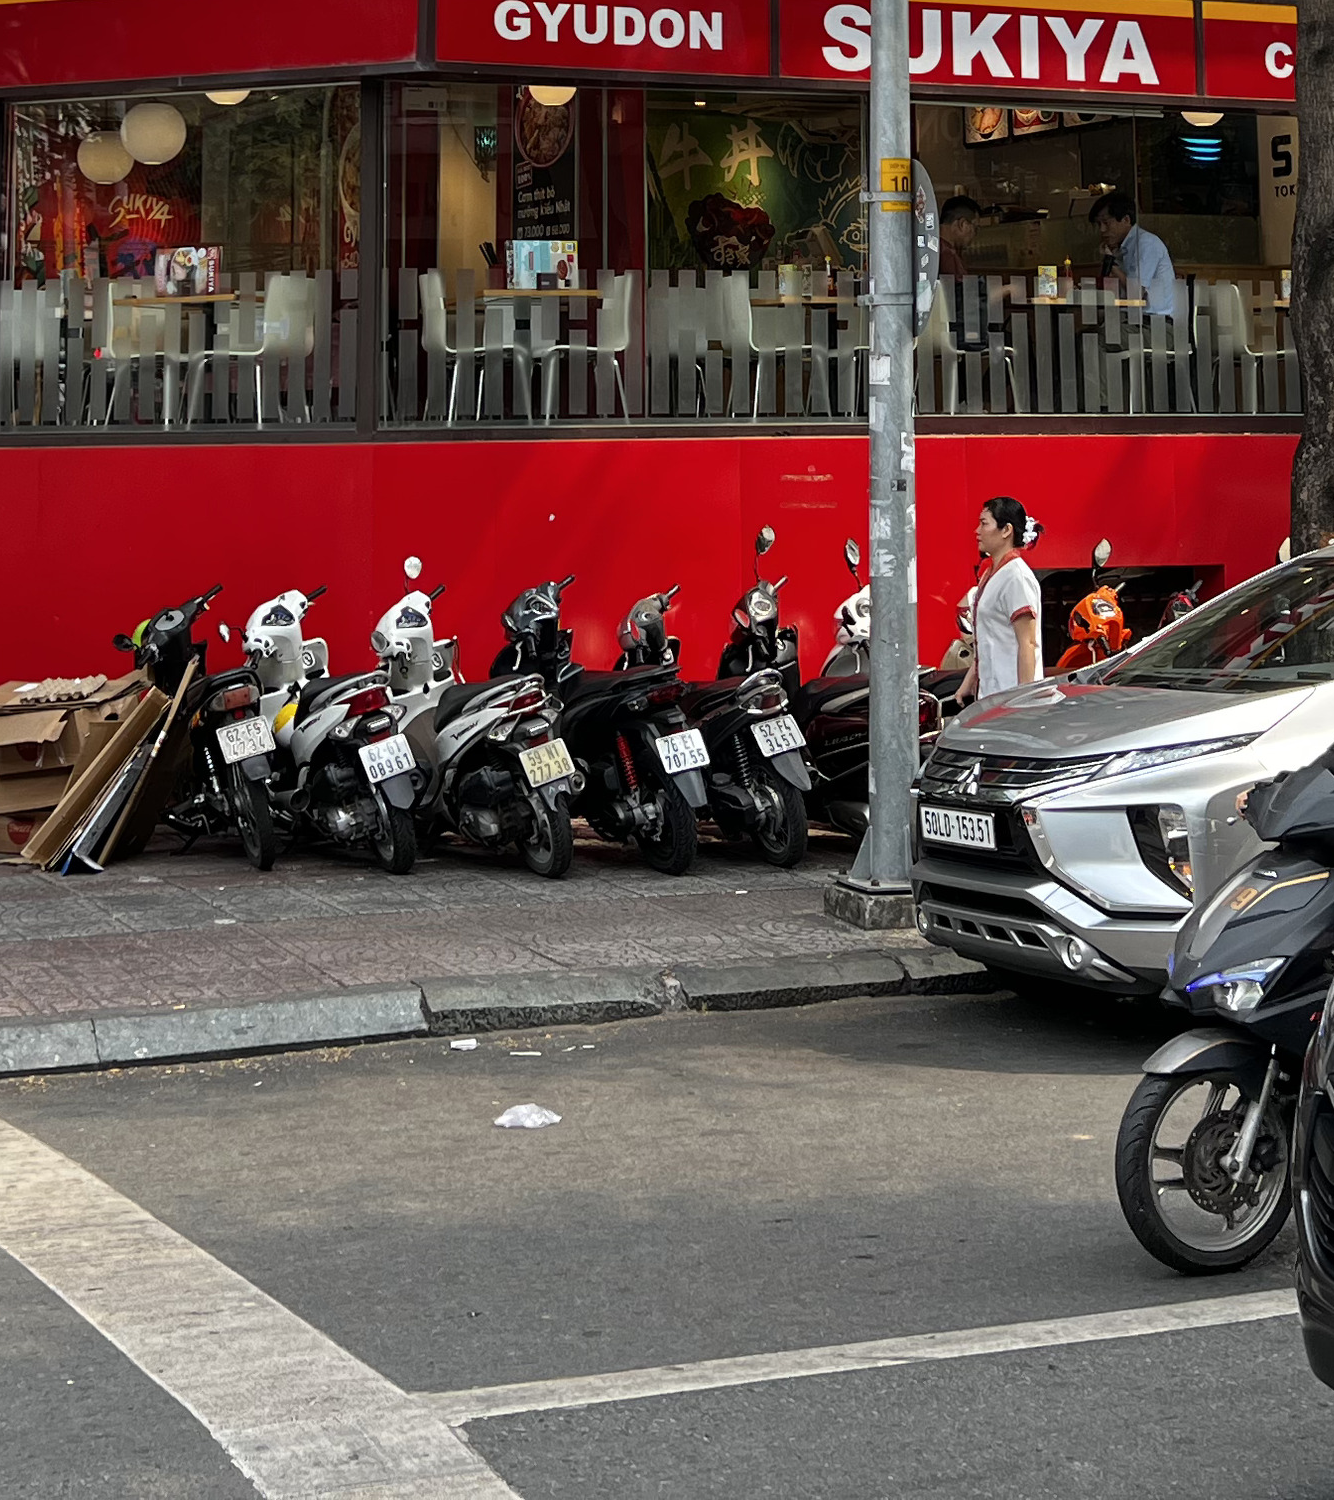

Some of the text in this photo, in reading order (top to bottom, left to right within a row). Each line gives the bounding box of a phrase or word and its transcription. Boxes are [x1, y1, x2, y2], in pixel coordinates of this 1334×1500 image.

[494, 0, 723, 51] GYUDON
[108, 193, 174, 229] SUKIYA
[369, 752, 413, 779] 089.61
[665, 747, 706, 772] 707.55
[922, 806, 993, 847] 50LD-153.51
